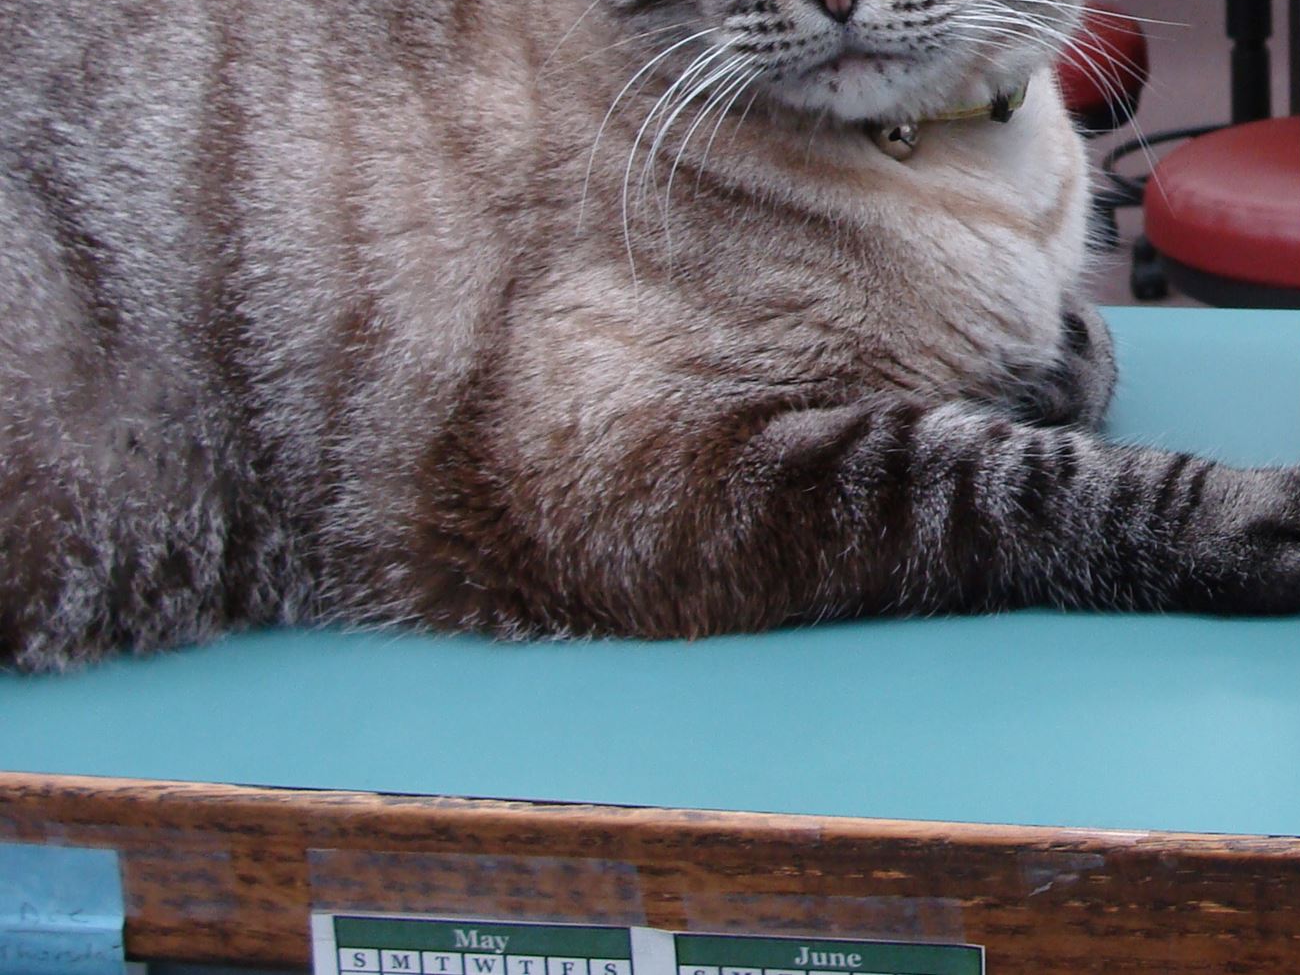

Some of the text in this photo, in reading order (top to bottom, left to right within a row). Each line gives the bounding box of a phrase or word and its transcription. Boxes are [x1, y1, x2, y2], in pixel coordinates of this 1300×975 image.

[453, 928, 510, 954] May
[353, 951, 618, 975] S M T W T F S
[794, 946, 864, 969] June
